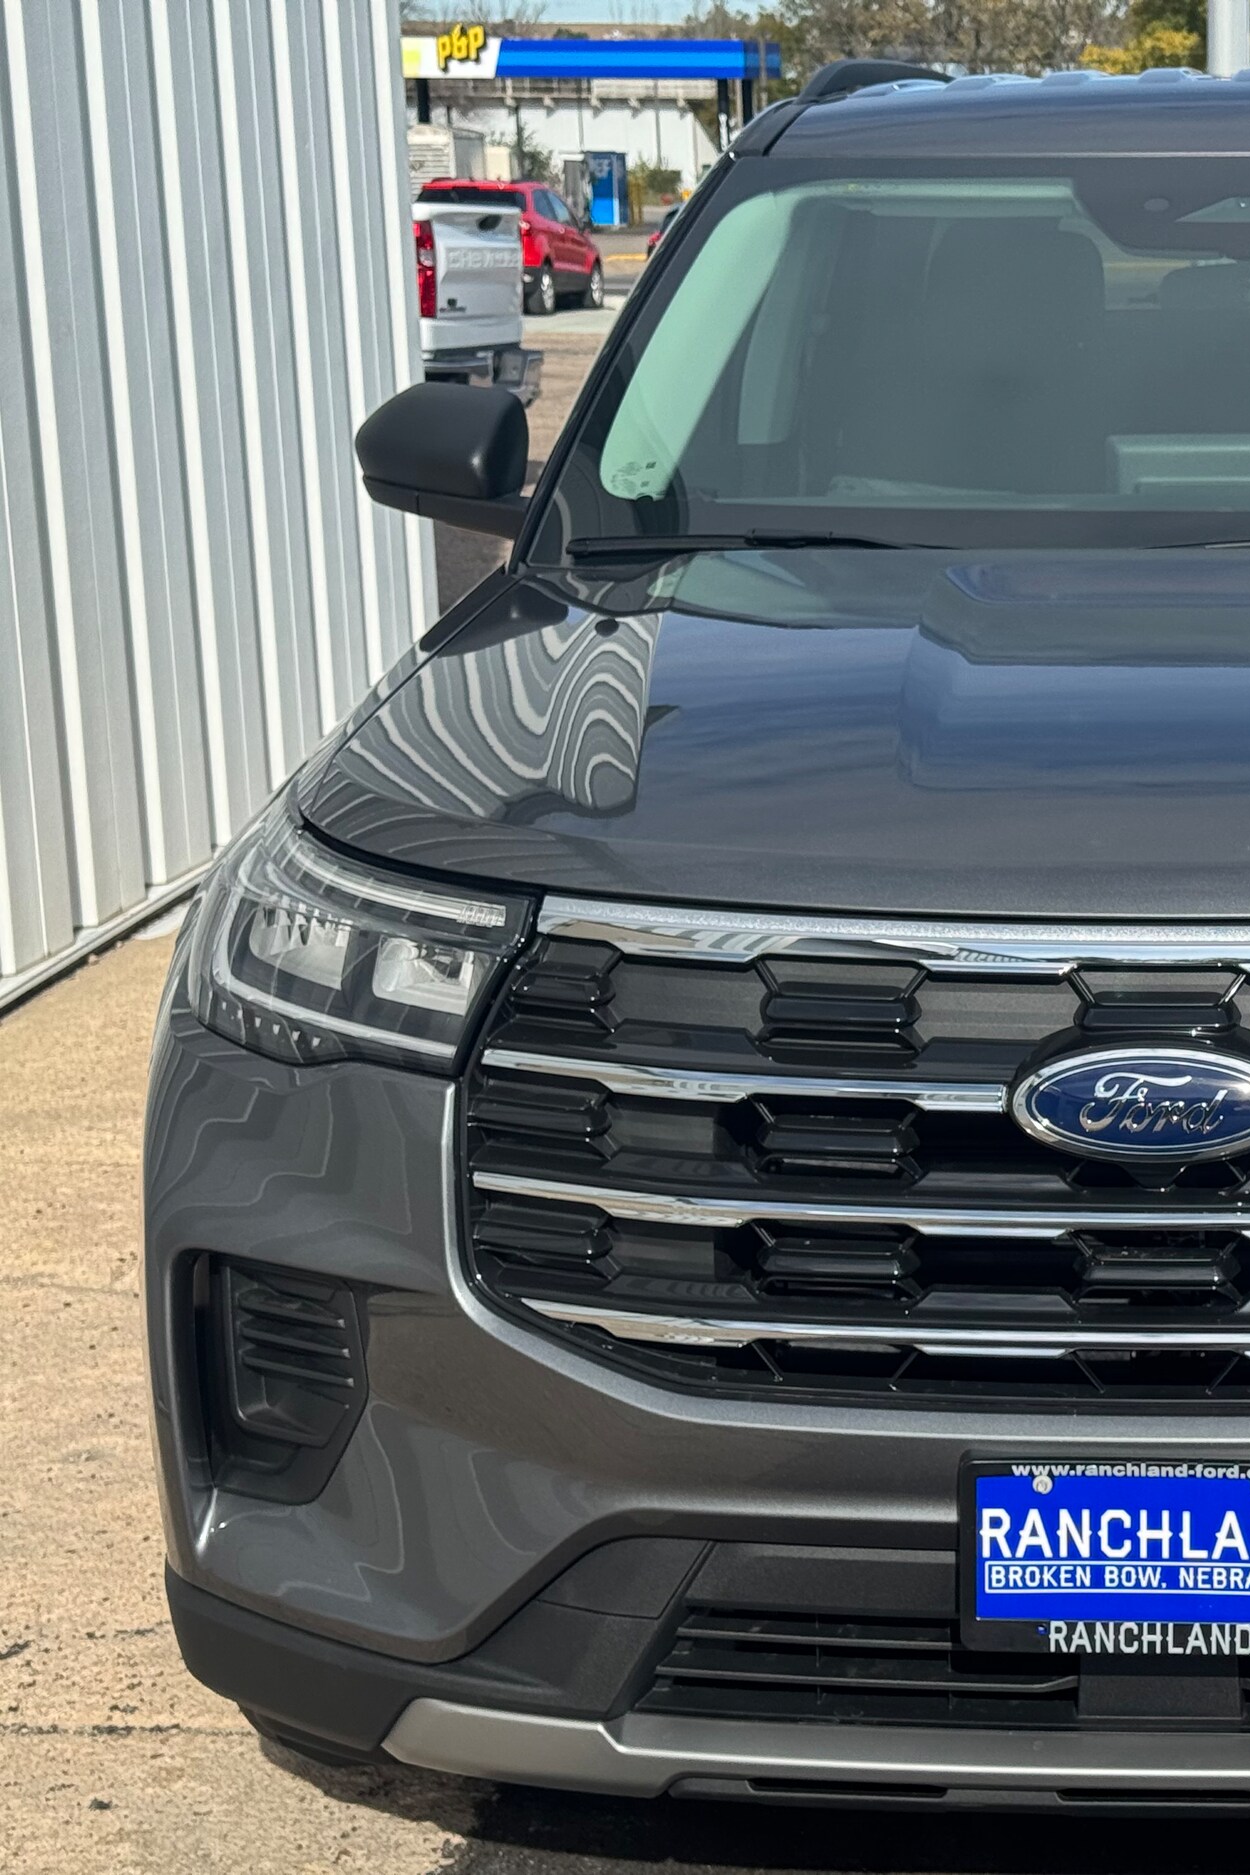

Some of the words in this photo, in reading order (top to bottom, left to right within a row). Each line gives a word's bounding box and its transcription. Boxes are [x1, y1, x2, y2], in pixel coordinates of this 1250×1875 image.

[1079, 1071, 1229, 1134] Ford
[990, 1565, 1091, 1588] BROKEN
[1104, 1566, 1168, 1590] BOW,
